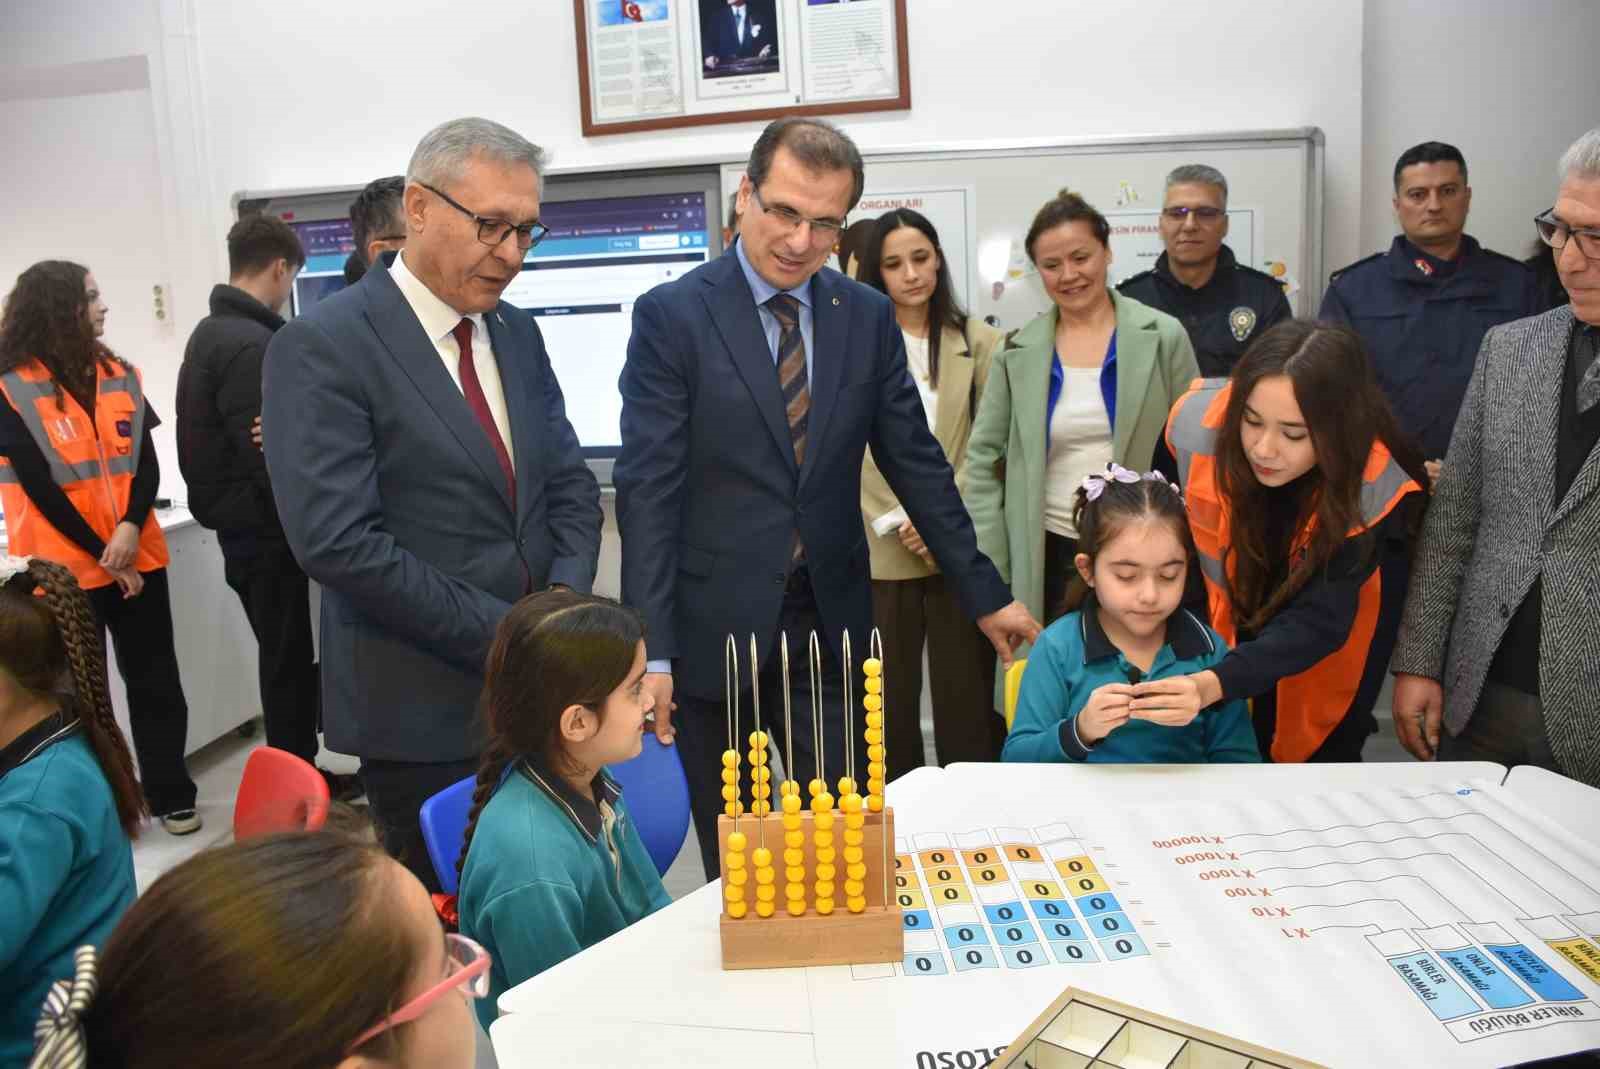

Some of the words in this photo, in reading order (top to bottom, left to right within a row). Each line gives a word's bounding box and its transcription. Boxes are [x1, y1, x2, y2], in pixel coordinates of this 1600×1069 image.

[931, 852, 945, 863] 0
[974, 852, 988, 864] 0
[1016, 848, 1031, 859] 0
[1175, 852, 1225, 865] 10000
[937, 870, 952, 881] 0
[981, 869, 996, 881] 0
[1068, 861, 1083, 872] 0
[1199, 869, 1241, 881] 1000
[898, 894, 913, 906] 0
[943, 888, 958, 900] 0
[1034, 884, 1049, 896] 0
[1079, 879, 1094, 891] 0
[1224, 887, 1257, 898] 100
[903, 914, 919, 927] 0
[997, 907, 1013, 920] 0
[1044, 903, 1060, 916] 0
[1090, 897, 1106, 910] 0
[1251, 907, 1275, 917] 10
[958, 928, 974, 942] 0
[1006, 927, 1023, 942] 0
[1054, 923, 1071, 937] 0
[1102, 917, 1119, 931] 0
[915, 957, 932, 971] 0
[966, 950, 982, 965] 0
[1016, 950, 1033, 964] 0
[1066, 945, 1083, 959] 0
[1115, 939, 1133, 954] 0
[1466, 953, 1496, 976] ONLAR
[1396, 963, 1439, 1001] BASAMAĞI
[1416, 959, 1447, 984] BİRLER
[1469, 1012, 1530, 1034] BÖLÜĞÜ
[1529, 1005, 1585, 1021] BİRLER
